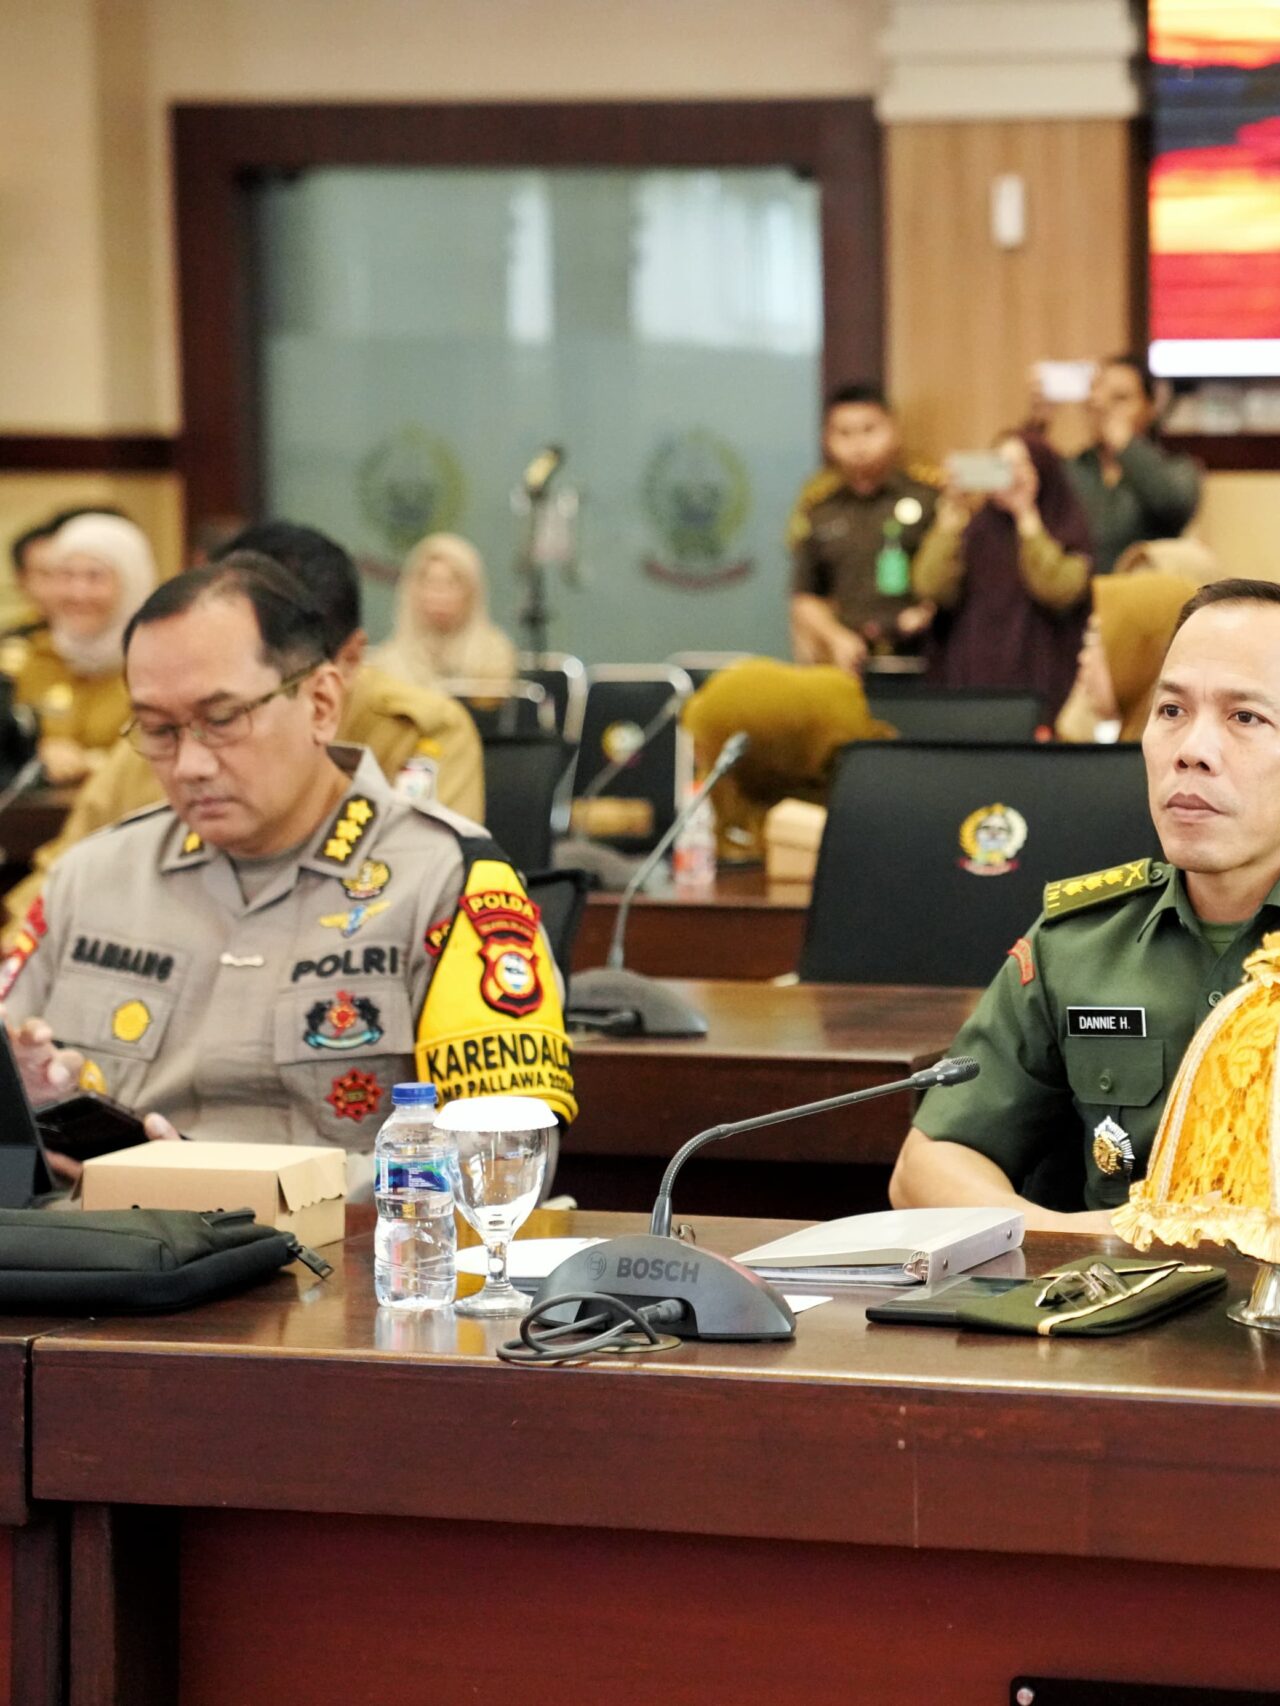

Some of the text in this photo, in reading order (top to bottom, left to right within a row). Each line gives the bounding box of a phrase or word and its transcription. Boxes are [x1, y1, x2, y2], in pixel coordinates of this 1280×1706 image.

[468, 893, 536, 919] POLDA
[291, 946, 399, 983] POLRI
[1079, 1016, 1131, 1030] DANNIE H.
[468, 1071, 545, 1098] PALLAWA
[616, 1256, 700, 1284] BOSCH
